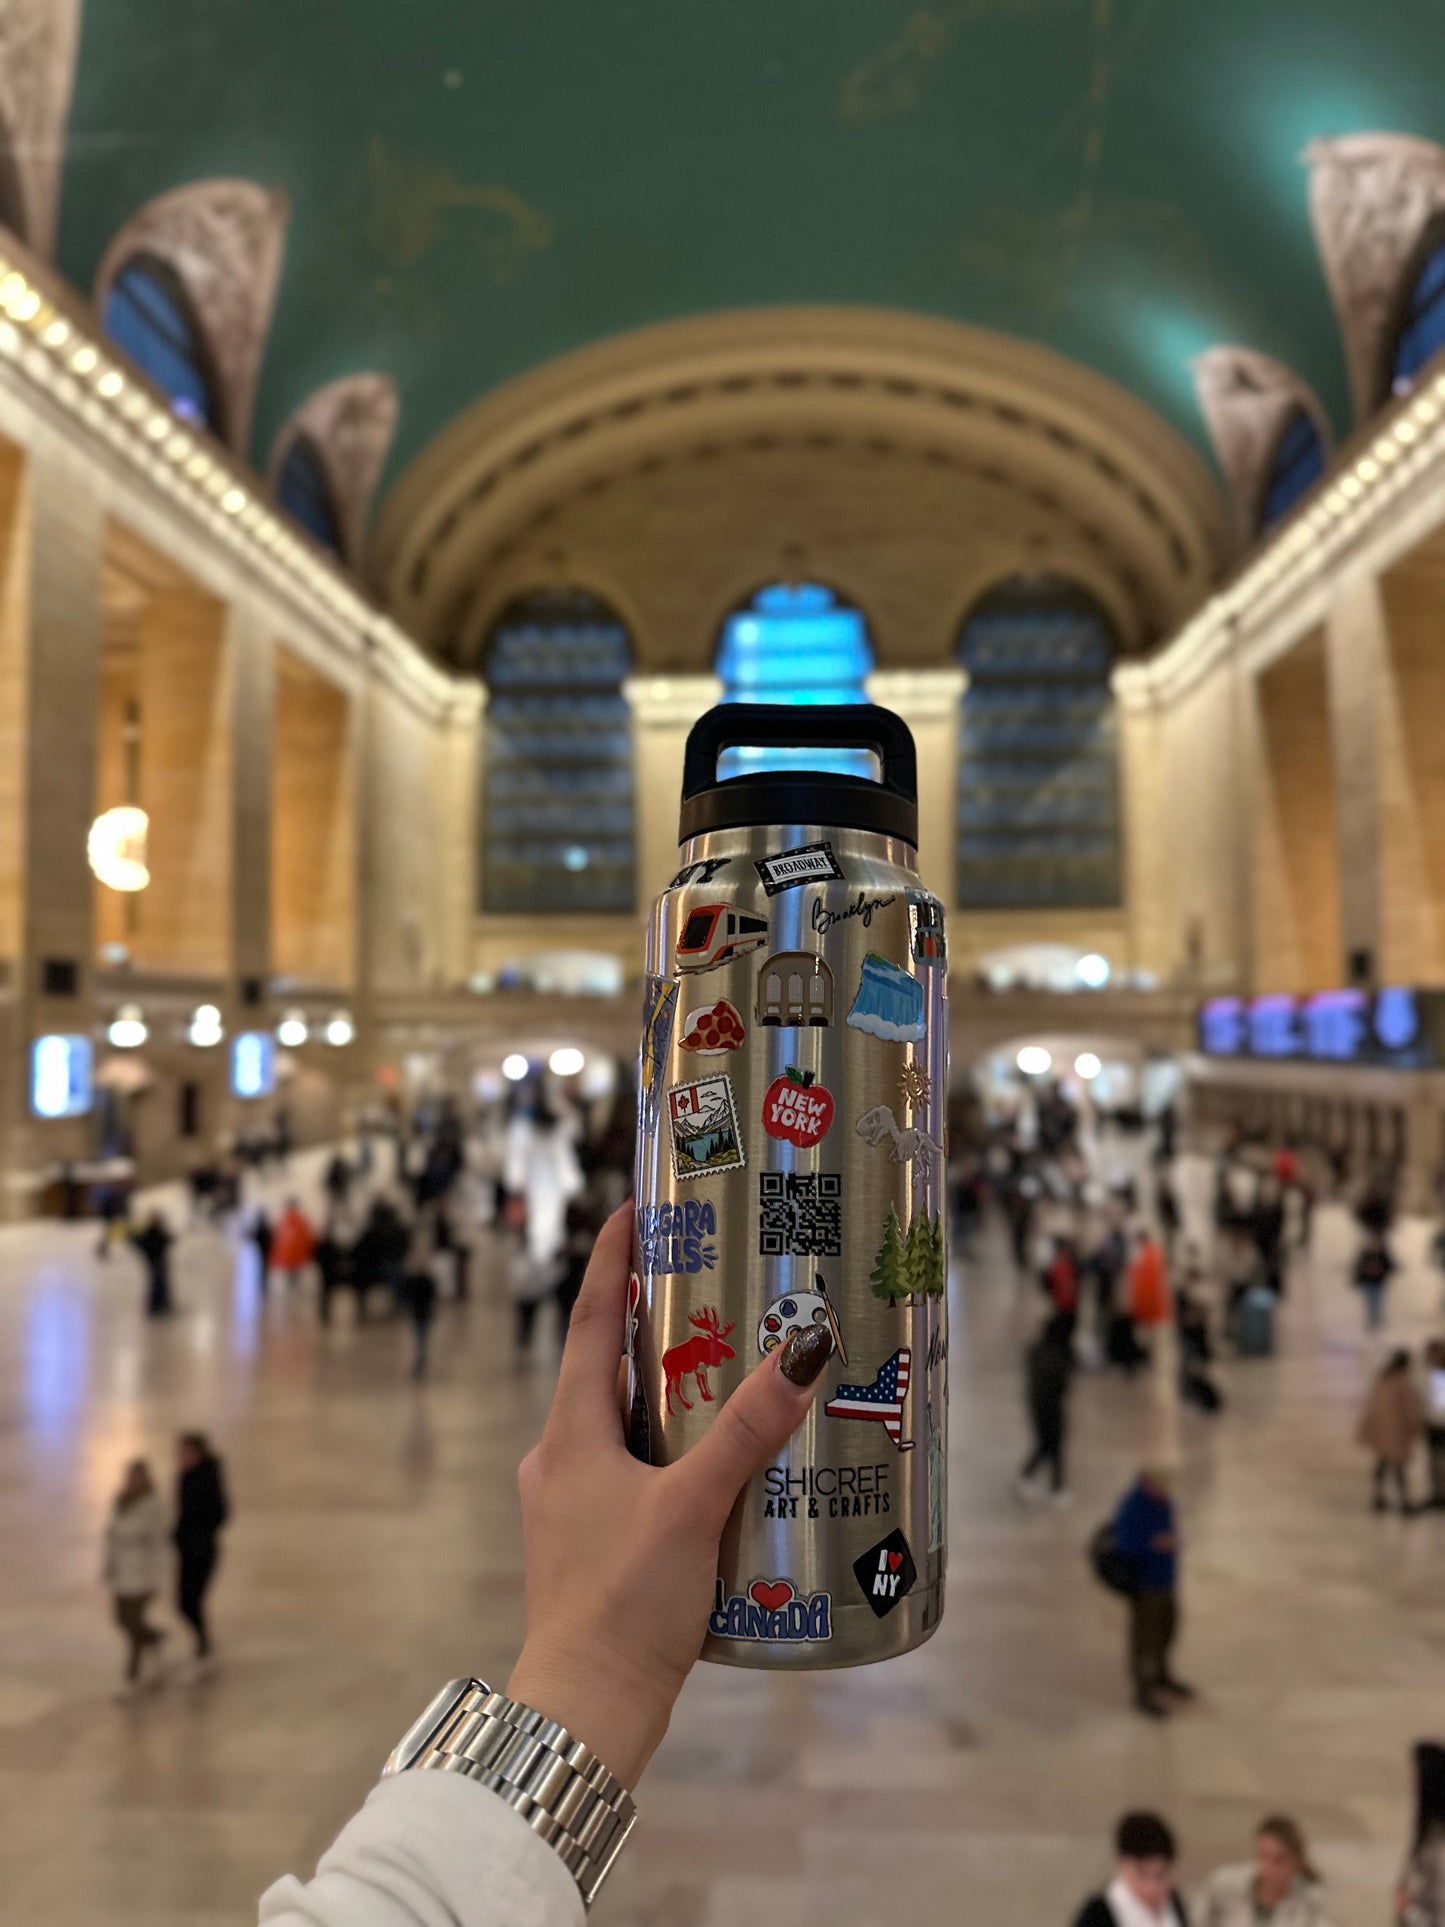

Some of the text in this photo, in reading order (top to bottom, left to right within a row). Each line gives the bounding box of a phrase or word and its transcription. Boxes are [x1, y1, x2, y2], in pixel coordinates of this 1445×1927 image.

[773, 856, 827, 877] BROADWAY
[812, 892, 896, 934] Brooklyn
[778, 1087, 826, 1117] NEW
[771, 1103, 821, 1136] YORK
[642, 1238, 703, 1276] FALLS
[765, 1464, 889, 1496] SHICREF
[764, 1493, 890, 1519] ART & CRAFTS
[878, 1549, 888, 1571] I
[872, 1573, 900, 1598] NY
[709, 1594, 830, 1639] CANADA
